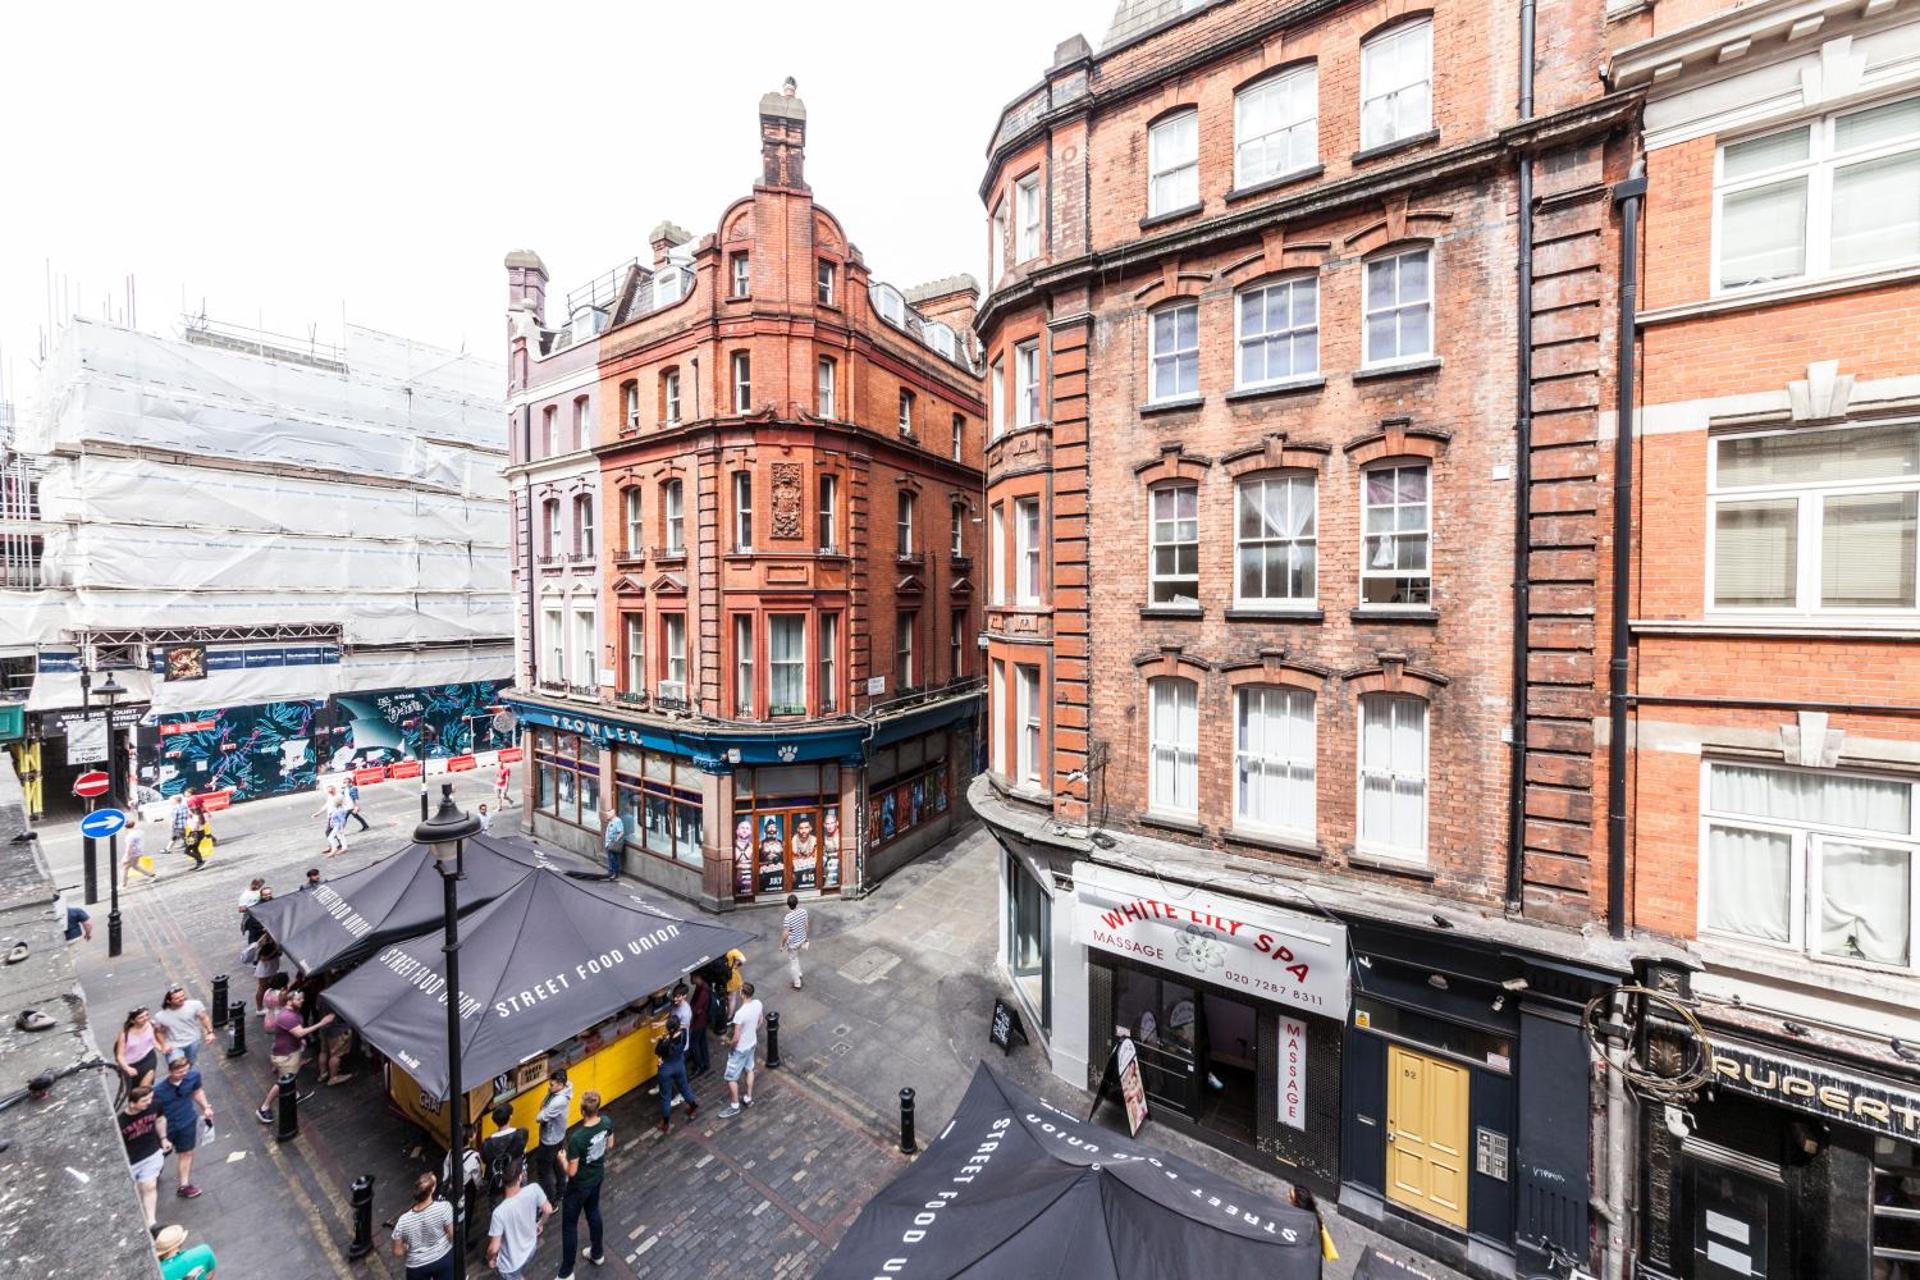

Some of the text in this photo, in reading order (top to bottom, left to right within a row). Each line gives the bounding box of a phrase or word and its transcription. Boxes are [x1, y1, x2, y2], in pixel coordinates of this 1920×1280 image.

[551, 714, 643, 745] PROWLER
[1092, 929, 1165, 961] MASSAGE
[1101, 900, 1178, 930] WHITE
[1254, 933, 1309, 983] SPA
[380, 948, 421, 978] STREET
[409, 966, 445, 995] FOOD
[495, 923, 680, 1018] STREET FOOD UNION
[1225, 971, 1323, 1006] 020 7287 8311
[1286, 1023, 1300, 1118] MASSAGE
[1711, 1055, 1920, 1132] RUPERT
[953, 1117, 1011, 1184] STREET
[902, 1192, 959, 1243] FOOD
[1191, 1187, 1298, 1243] STREET
